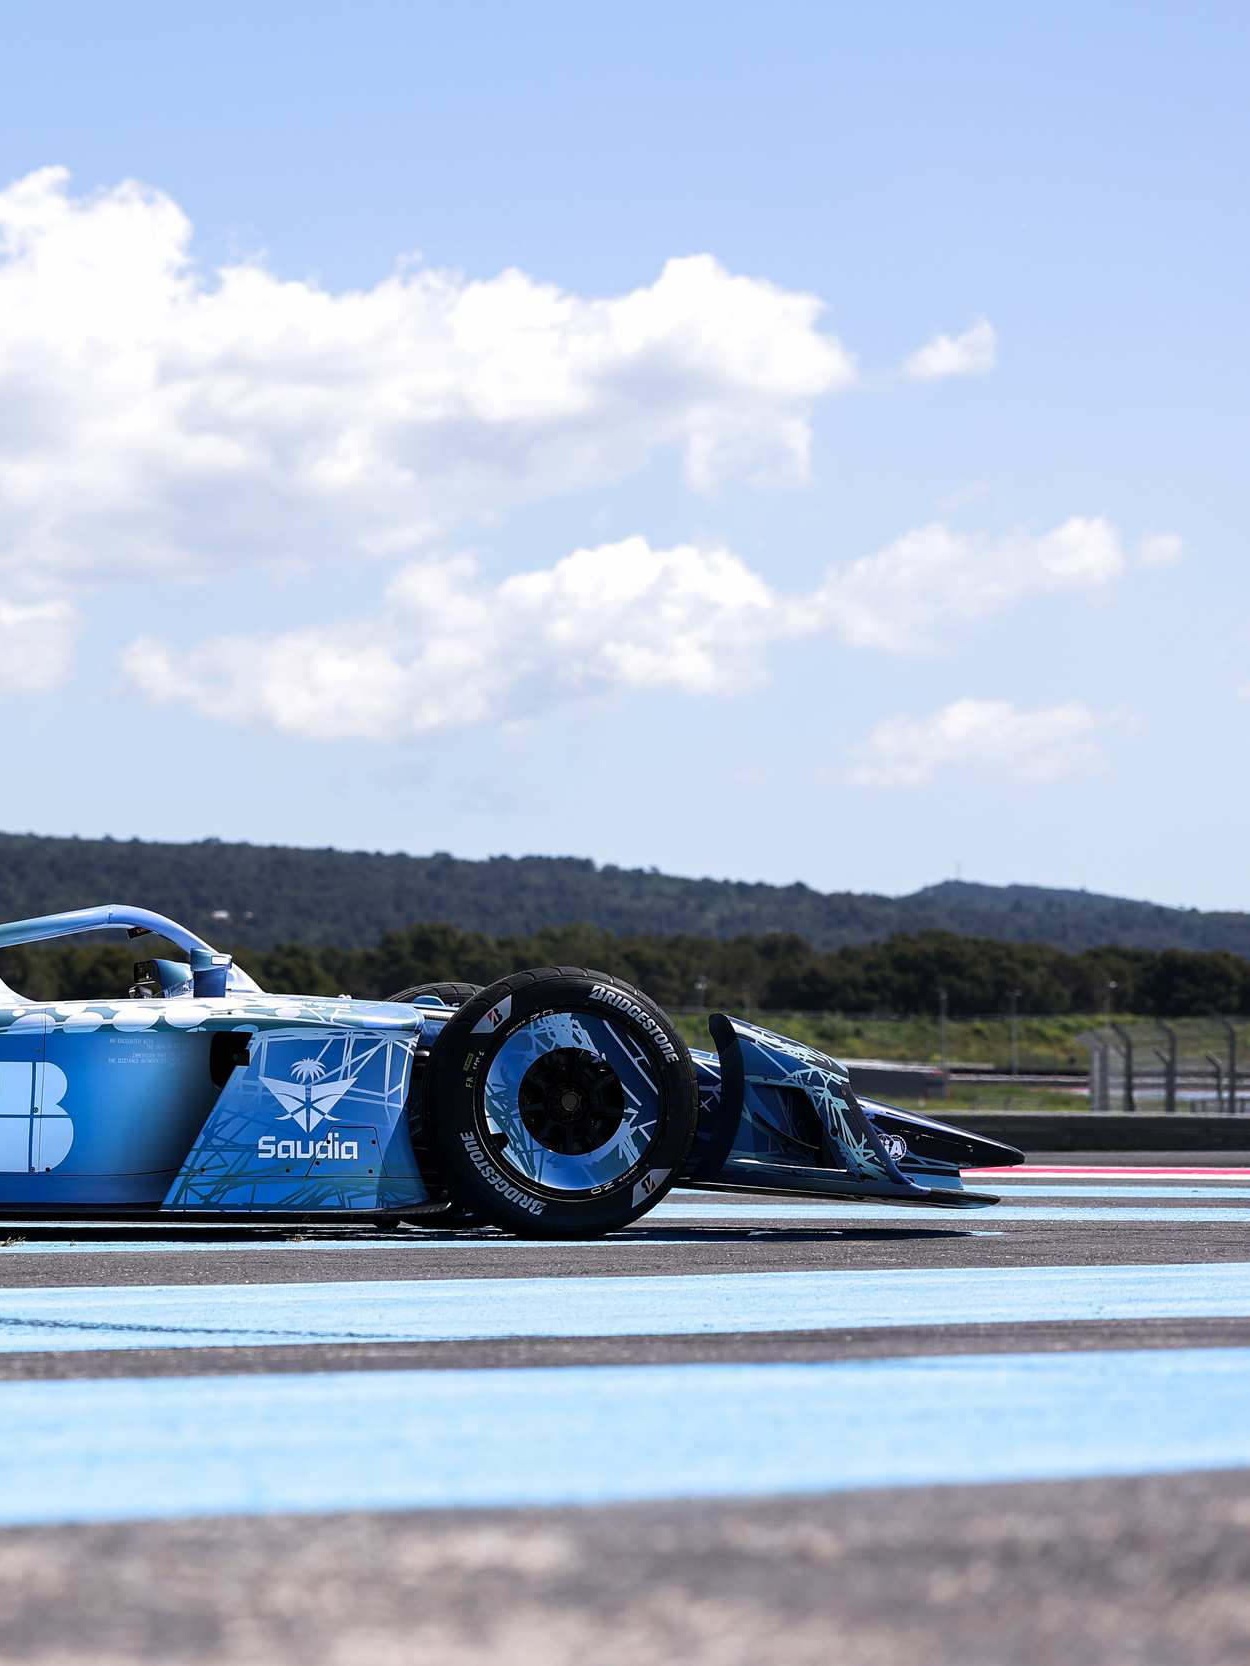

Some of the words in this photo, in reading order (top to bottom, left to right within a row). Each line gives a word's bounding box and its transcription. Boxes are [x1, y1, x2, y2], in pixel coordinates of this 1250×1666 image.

[588, 985, 680, 1064] BRIDGESTONE
[257, 1132, 359, 1160] Saudia
[459, 1131, 548, 1216] BRIDGESTONE
